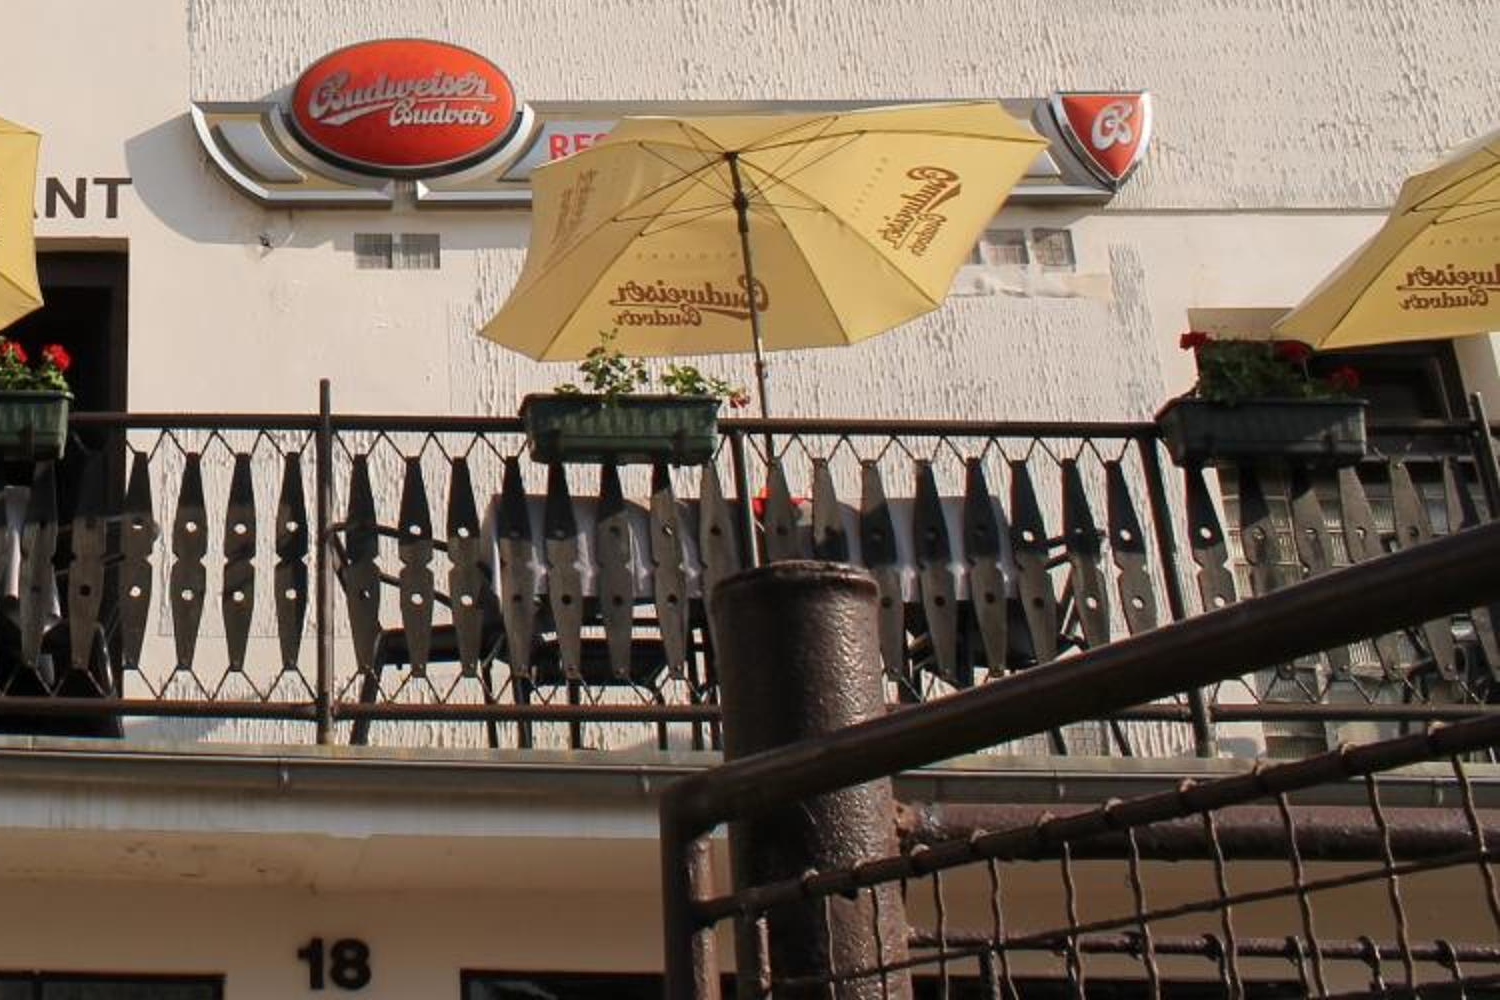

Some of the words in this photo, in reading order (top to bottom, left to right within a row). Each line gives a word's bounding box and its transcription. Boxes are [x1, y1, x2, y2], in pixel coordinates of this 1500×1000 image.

[308, 72, 495, 122] Budweiser
[389, 98, 493, 126] Budvar
[34, 177, 133, 218] NT
[297, 937, 372, 990] 18
